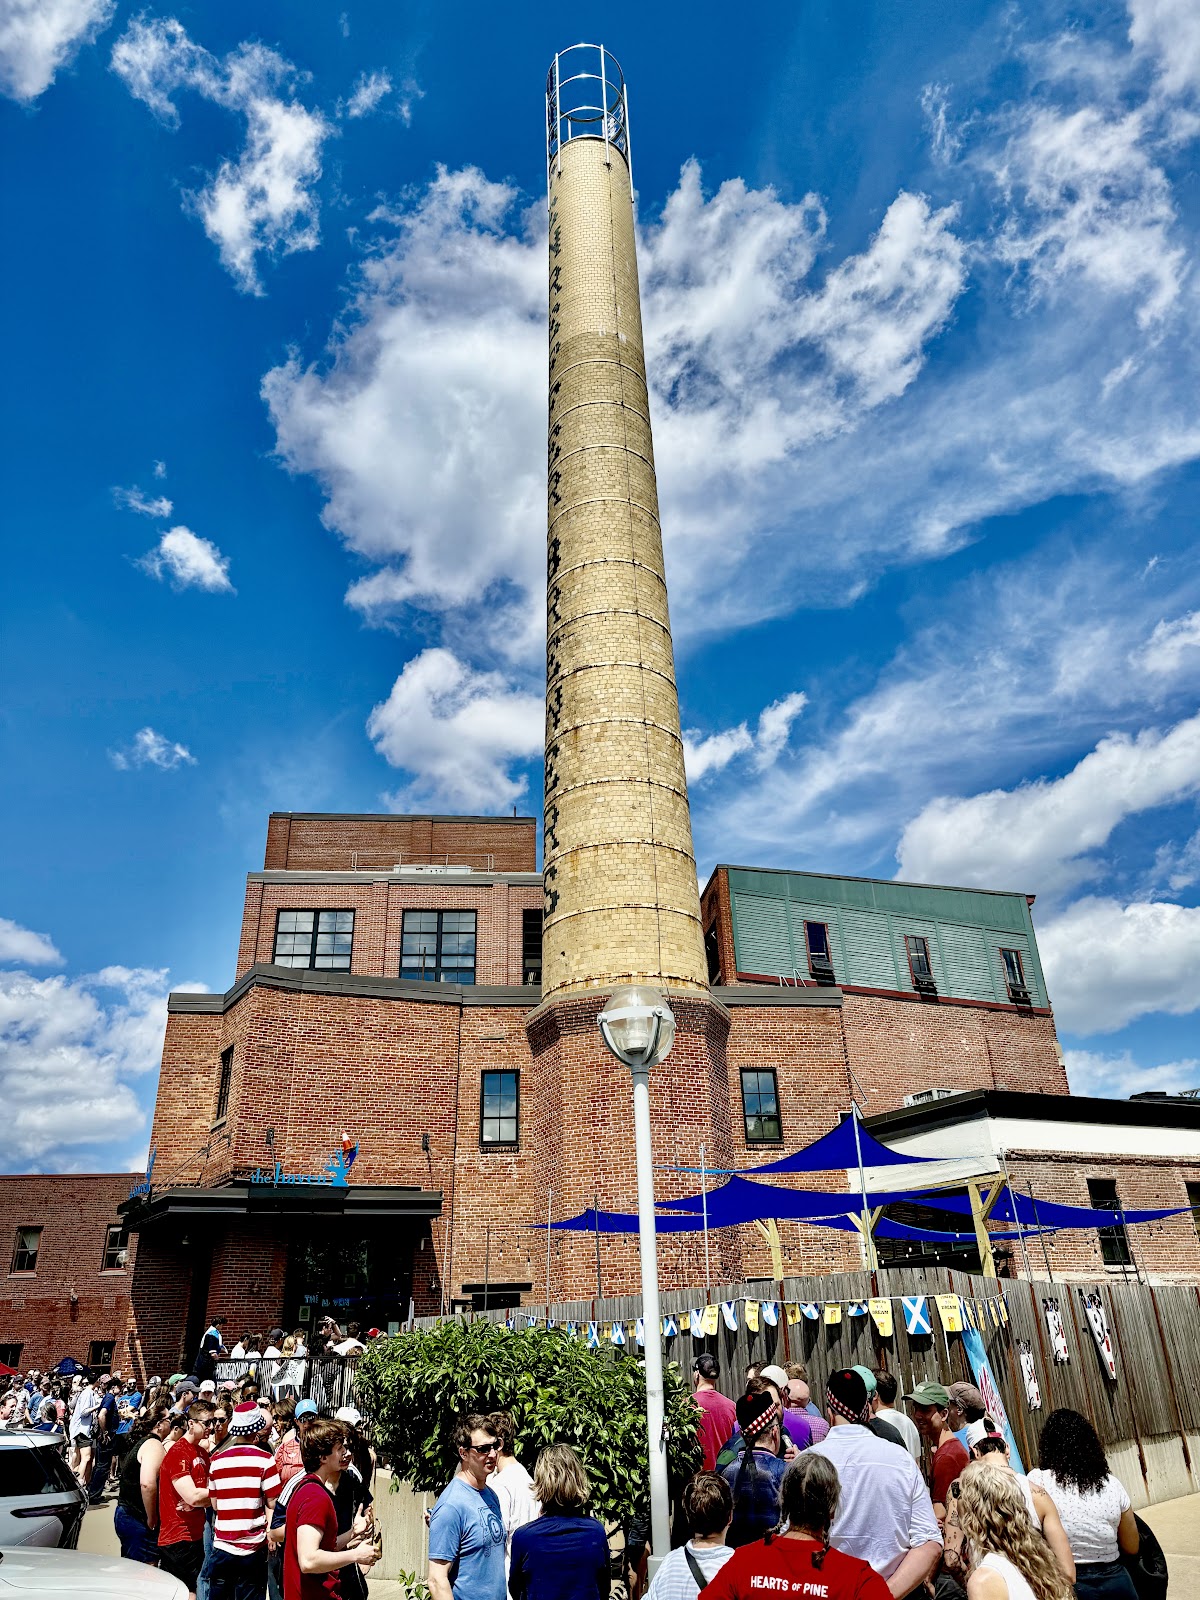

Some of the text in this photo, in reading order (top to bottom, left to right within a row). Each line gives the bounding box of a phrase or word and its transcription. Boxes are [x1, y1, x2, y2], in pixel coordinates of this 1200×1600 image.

[251, 1161, 327, 1185] the haven
[750, 1575, 829, 1598] HEARTS OF PINE
